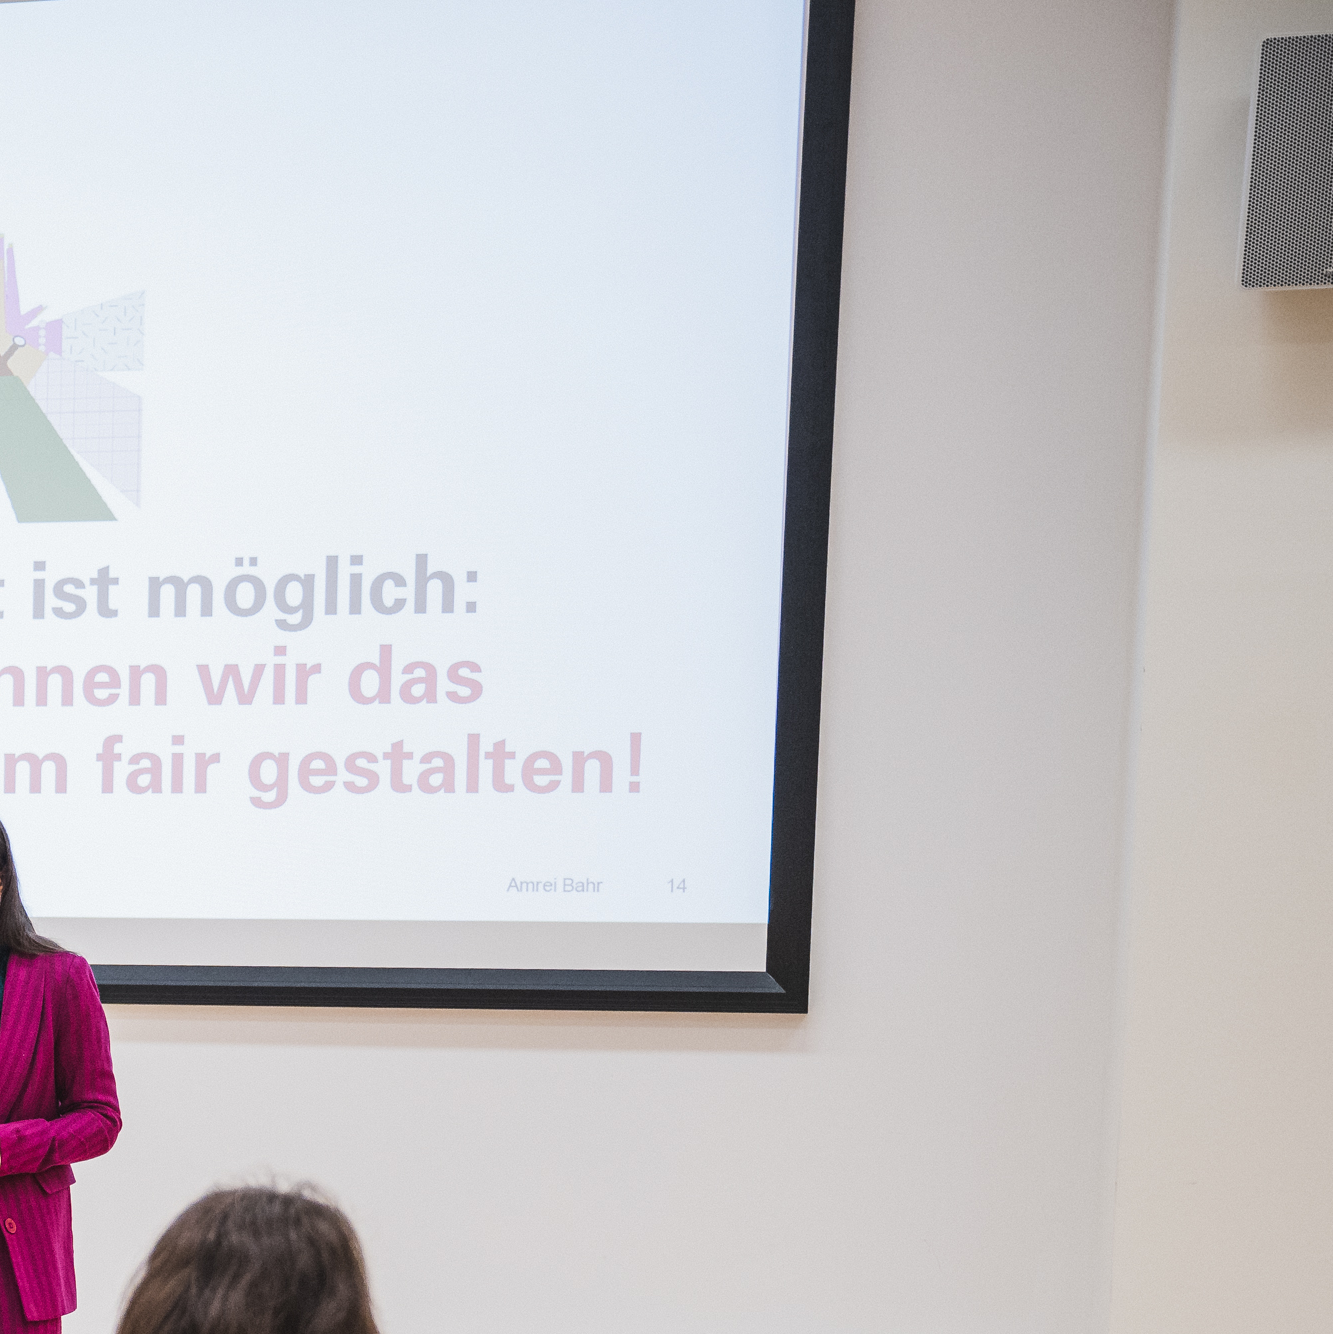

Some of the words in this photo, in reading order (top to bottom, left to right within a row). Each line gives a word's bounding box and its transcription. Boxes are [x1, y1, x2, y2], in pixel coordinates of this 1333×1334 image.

[31, 559, 121, 621] ist
[146, 552, 479, 634] möglich:
[195, 644, 323, 708] wir
[347, 643, 484, 706] das
[95, 733, 223, 797] fair
[247, 731, 645, 811] gestalten!
[506, 877, 558, 893] Amrei
[562, 877, 603, 893] Bahr
[667, 878, 688, 893] 14
